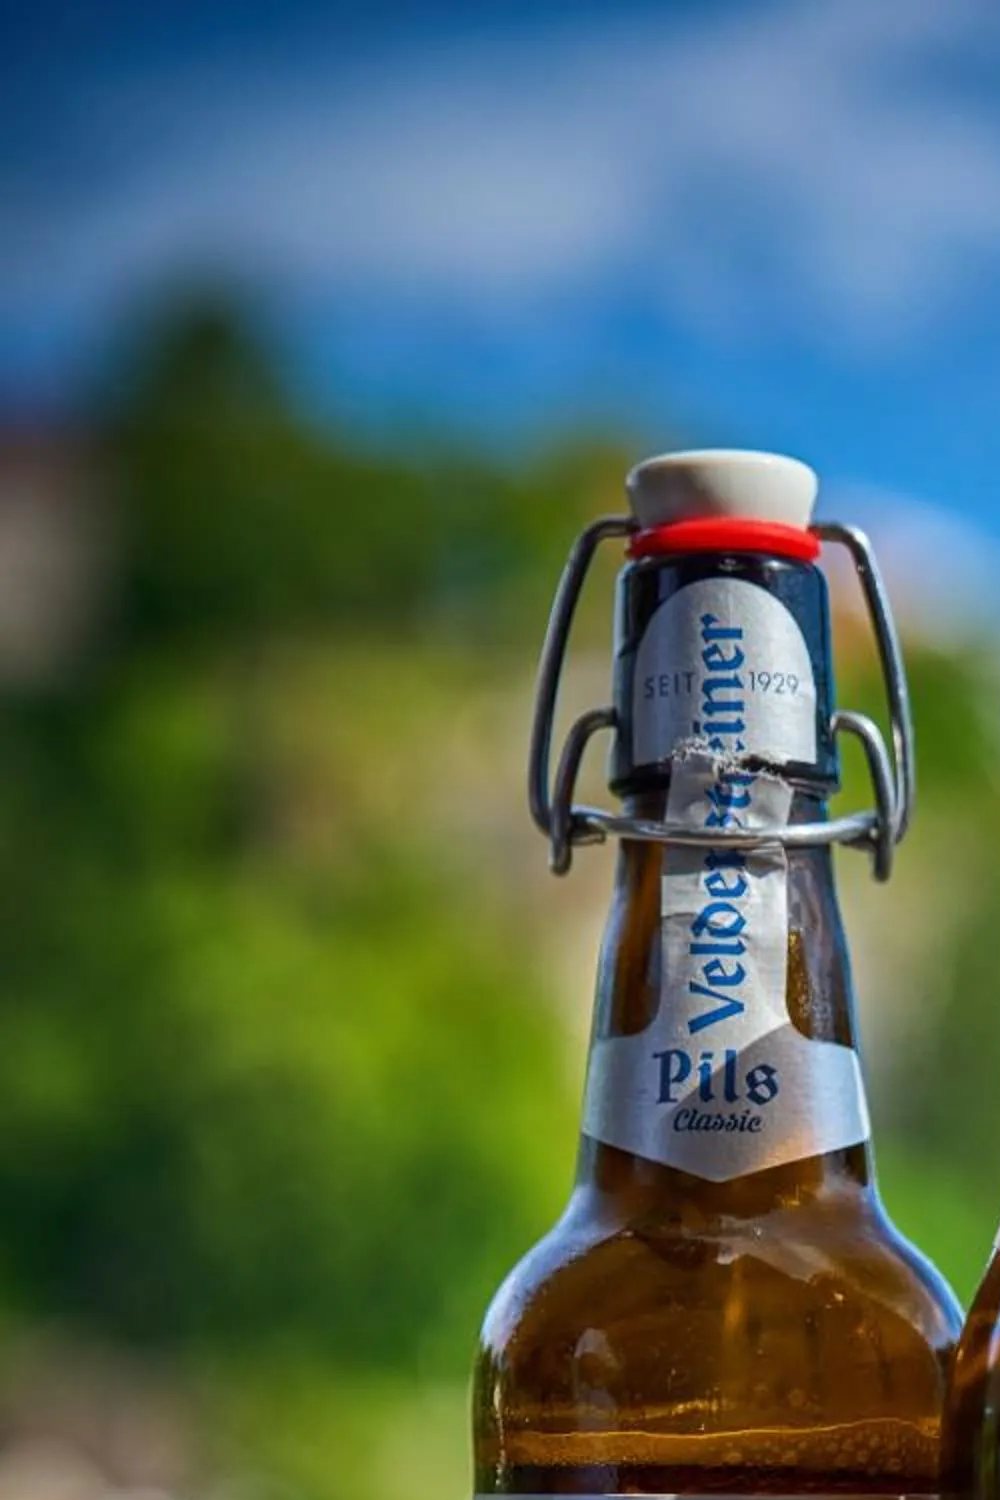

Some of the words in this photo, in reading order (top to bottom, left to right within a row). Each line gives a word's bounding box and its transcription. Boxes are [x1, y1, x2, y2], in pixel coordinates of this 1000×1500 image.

[644, 671, 695, 699] SEIT
[749, 671, 799, 696] 1929
[653, 1048, 779, 1105] Pils
[673, 1107, 762, 1134] Classic
